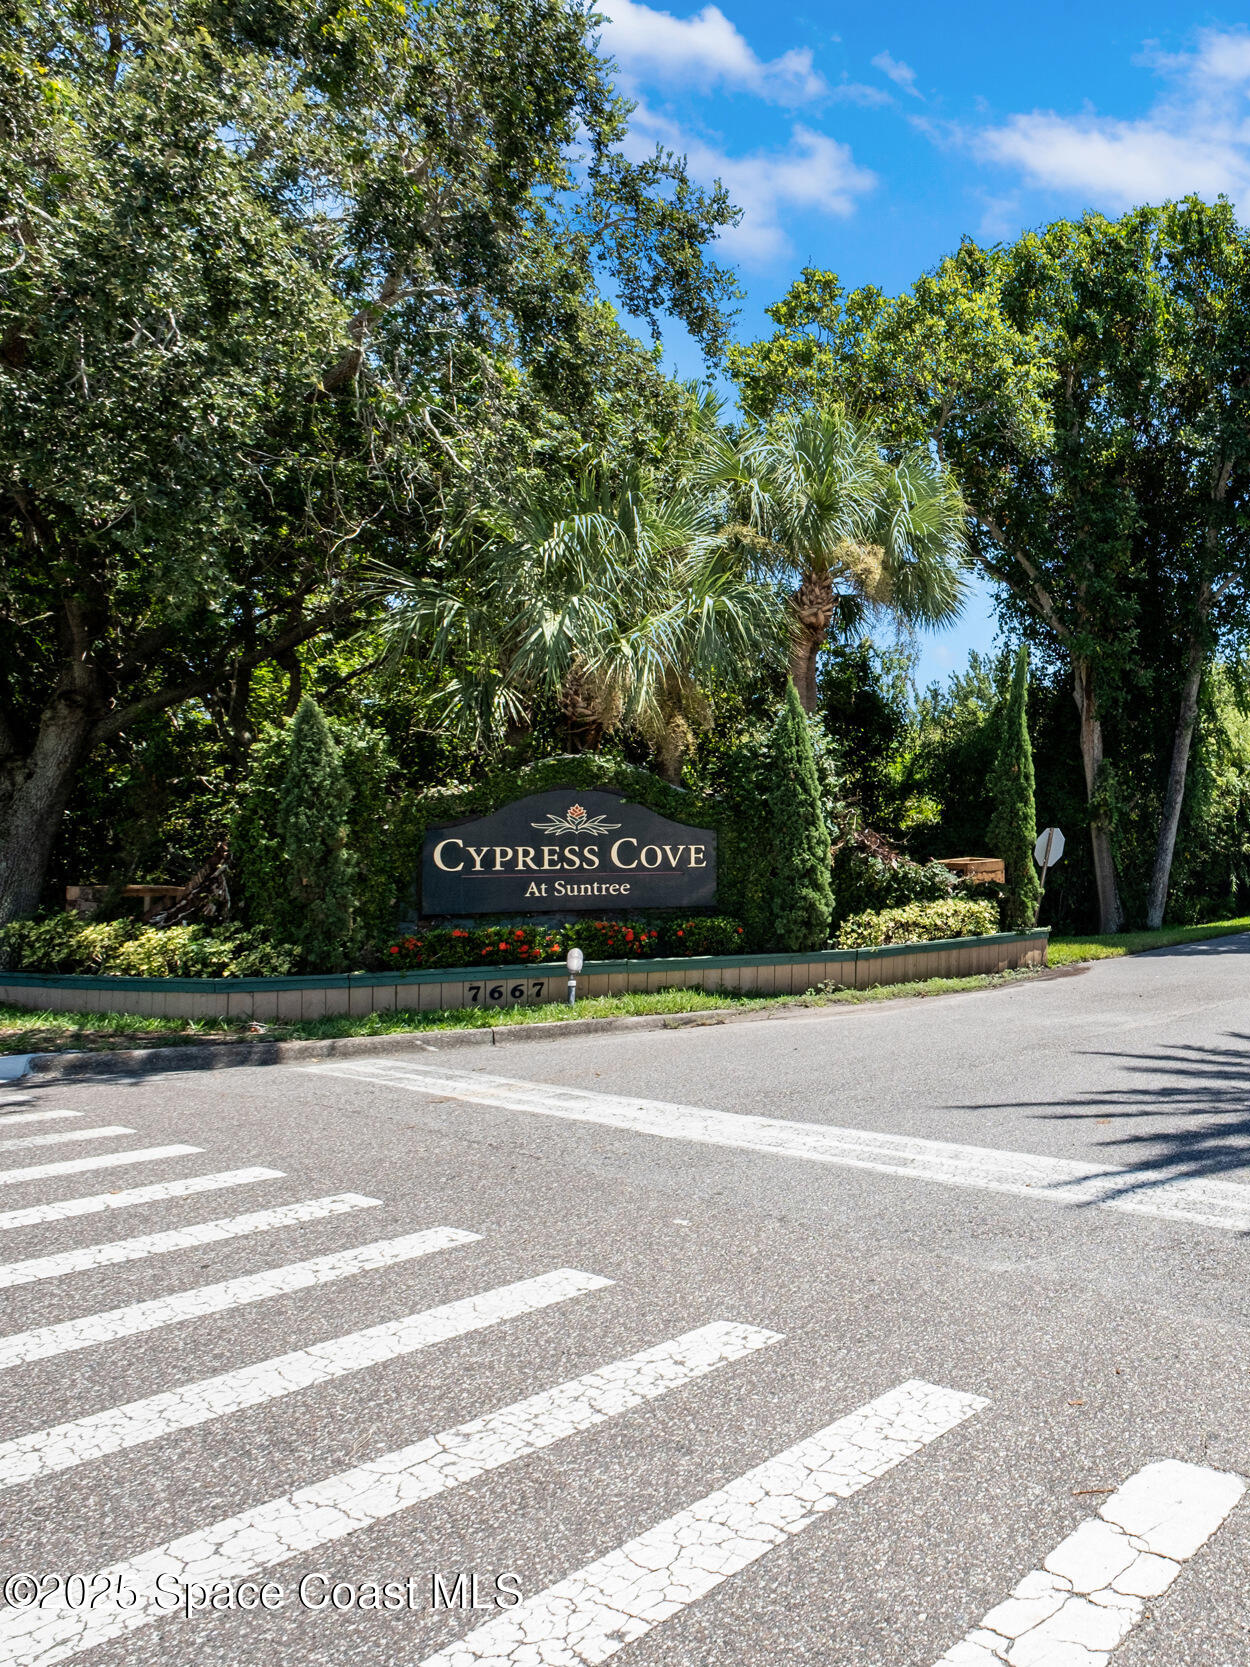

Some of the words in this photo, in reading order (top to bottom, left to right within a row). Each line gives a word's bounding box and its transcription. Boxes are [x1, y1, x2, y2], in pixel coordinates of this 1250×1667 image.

[433, 838, 600, 872] CYPRESS
[611, 837, 707, 869] COVE
[525, 881, 548, 897] At
[554, 880, 631, 896] Suntree
[468, 982, 545, 1002] 7667
